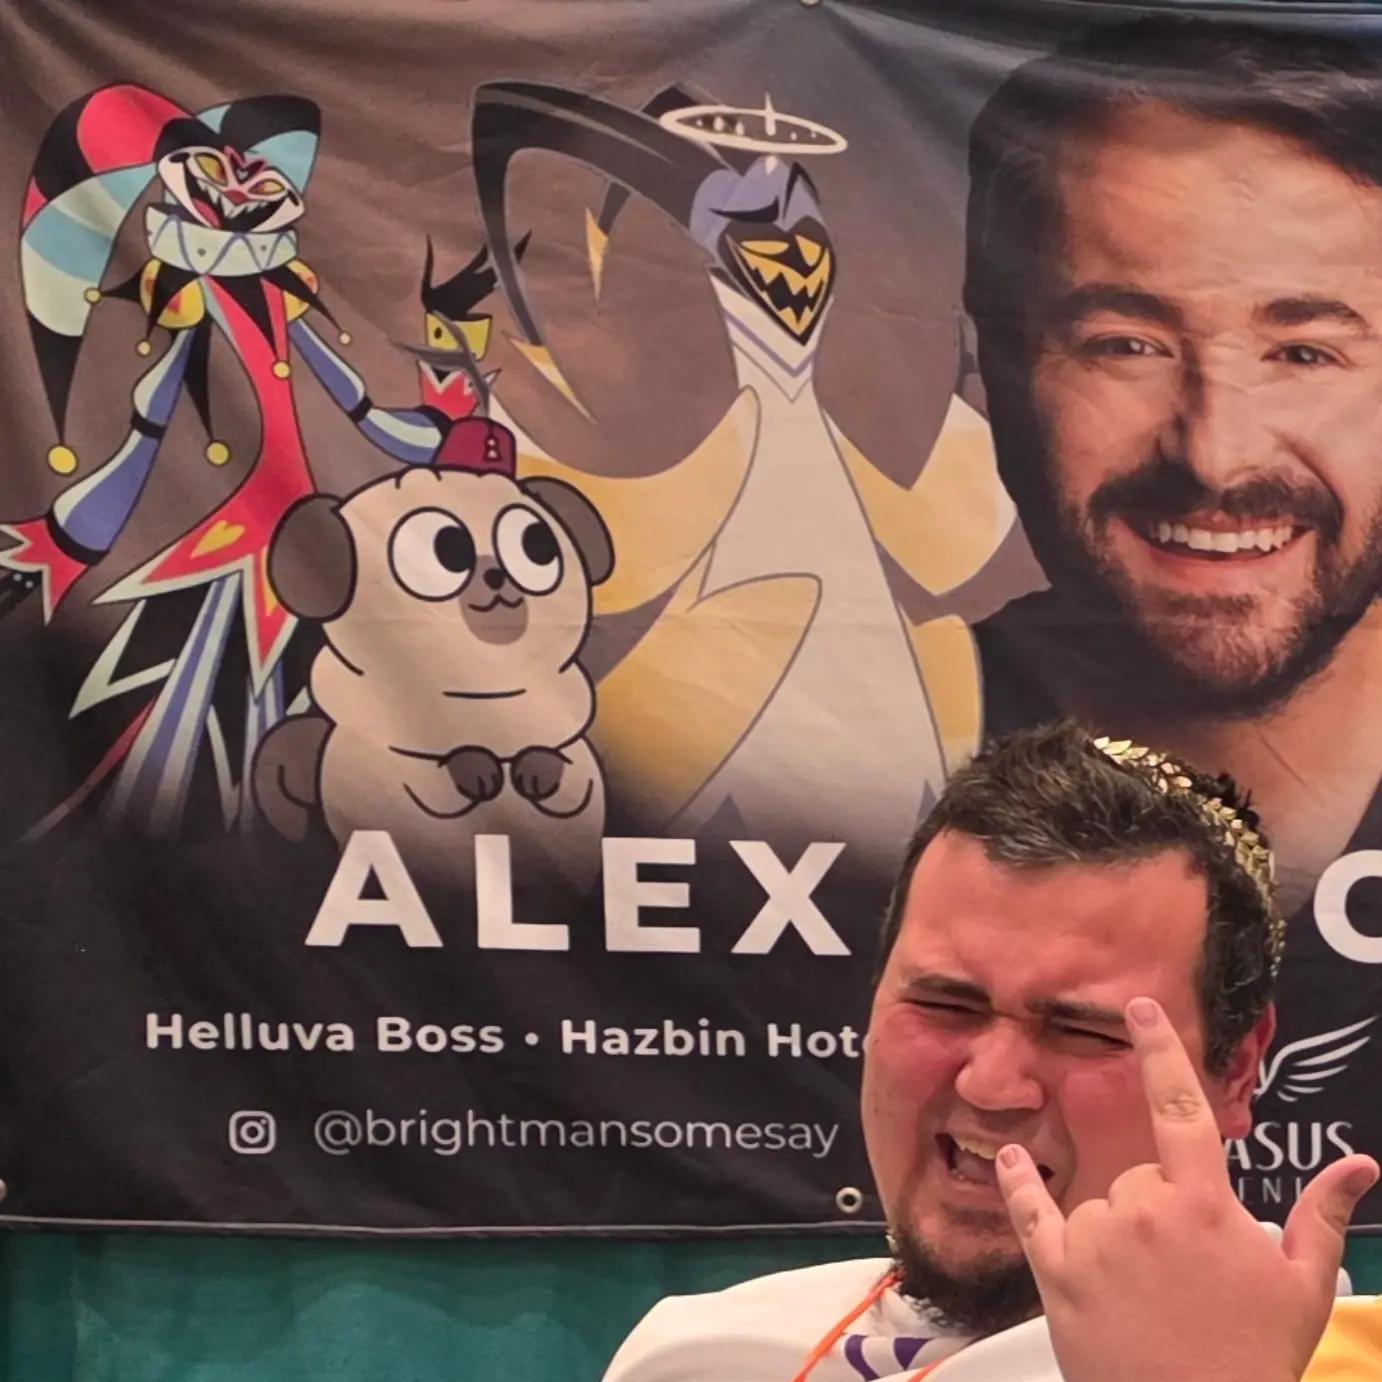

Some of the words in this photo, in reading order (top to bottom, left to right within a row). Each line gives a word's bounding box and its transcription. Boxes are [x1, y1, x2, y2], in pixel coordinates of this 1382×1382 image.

[304, 829, 852, 956] ALEX
[146, 1012, 355, 1052] Helluva
[377, 1016, 504, 1053] Boss
[561, 1017, 746, 1056] Hazbin
[767, 1022, 866, 1058] Hot
[313, 1109, 839, 1159] @brightmansomesay
[1225, 1121, 1353, 1171] ASUS
